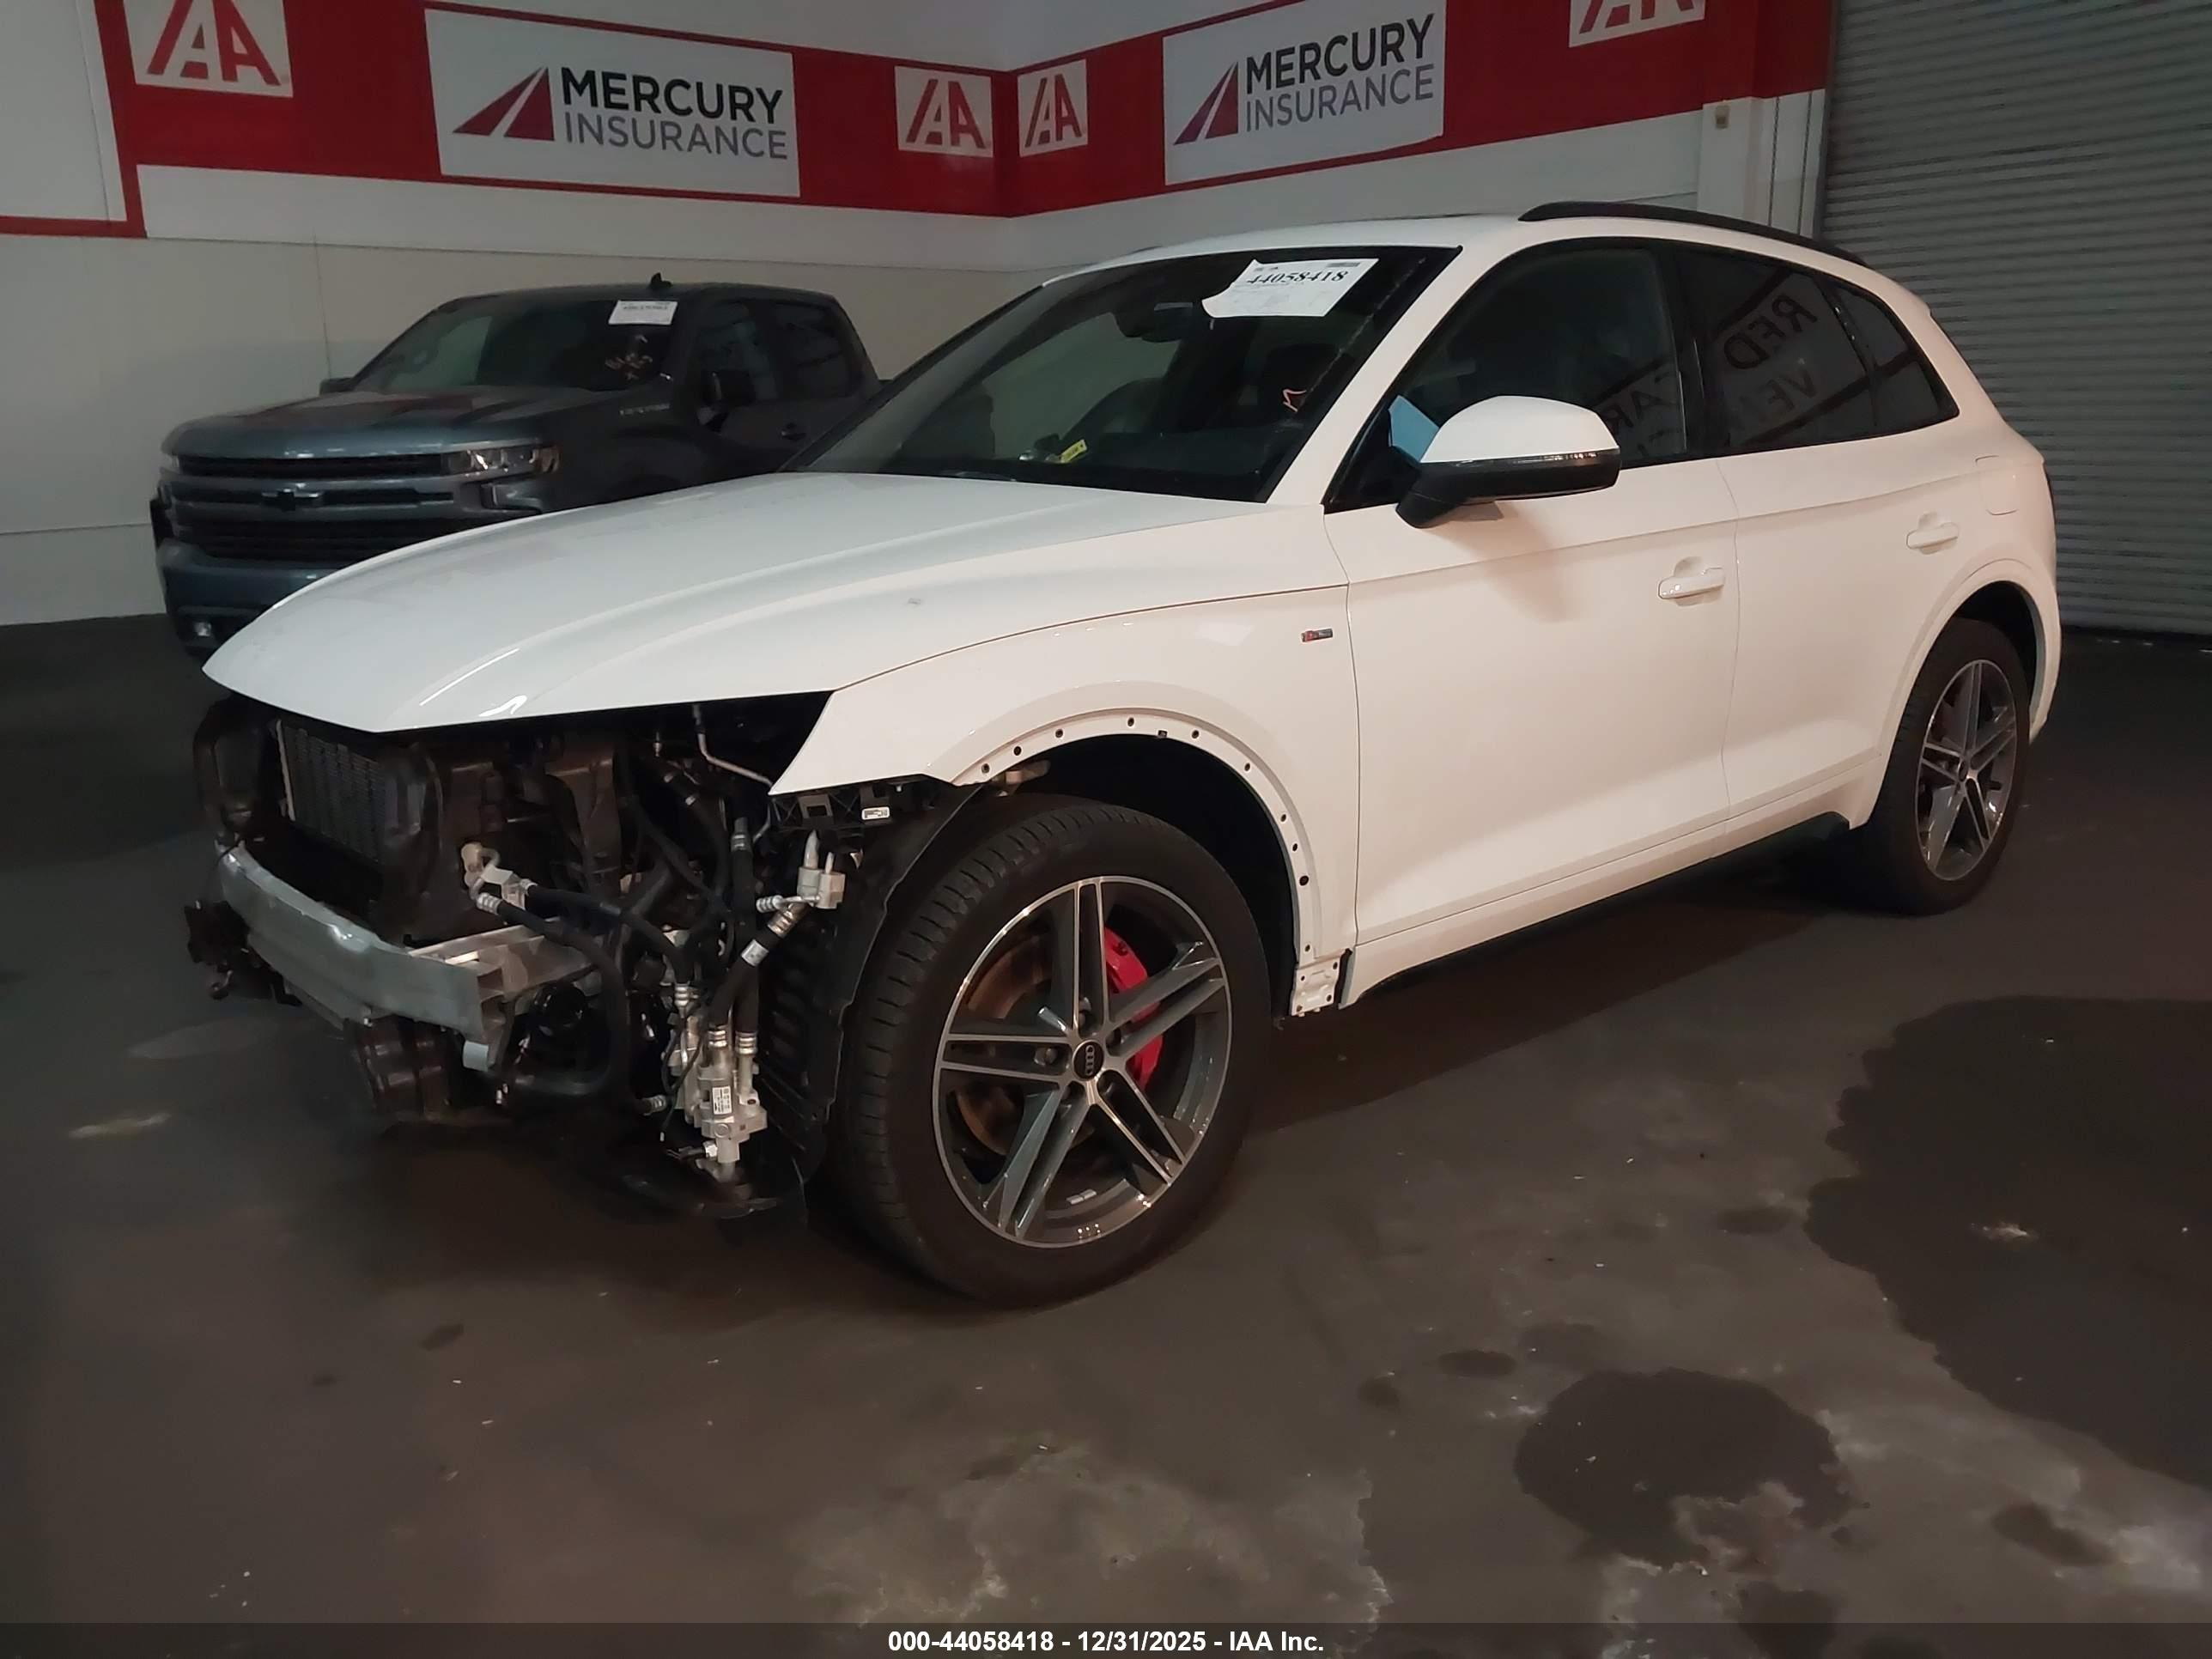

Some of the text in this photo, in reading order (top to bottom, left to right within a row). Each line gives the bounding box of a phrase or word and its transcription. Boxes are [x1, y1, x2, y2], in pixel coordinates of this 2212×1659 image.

[1246, 12, 1436, 95] MERCURY
[561, 66, 783, 125] MERCURY
[1246, 63, 1435, 132] INSURANCE
[564, 112, 788, 160] INSURANCE
[1246, 270, 1349, 285] 44058418
